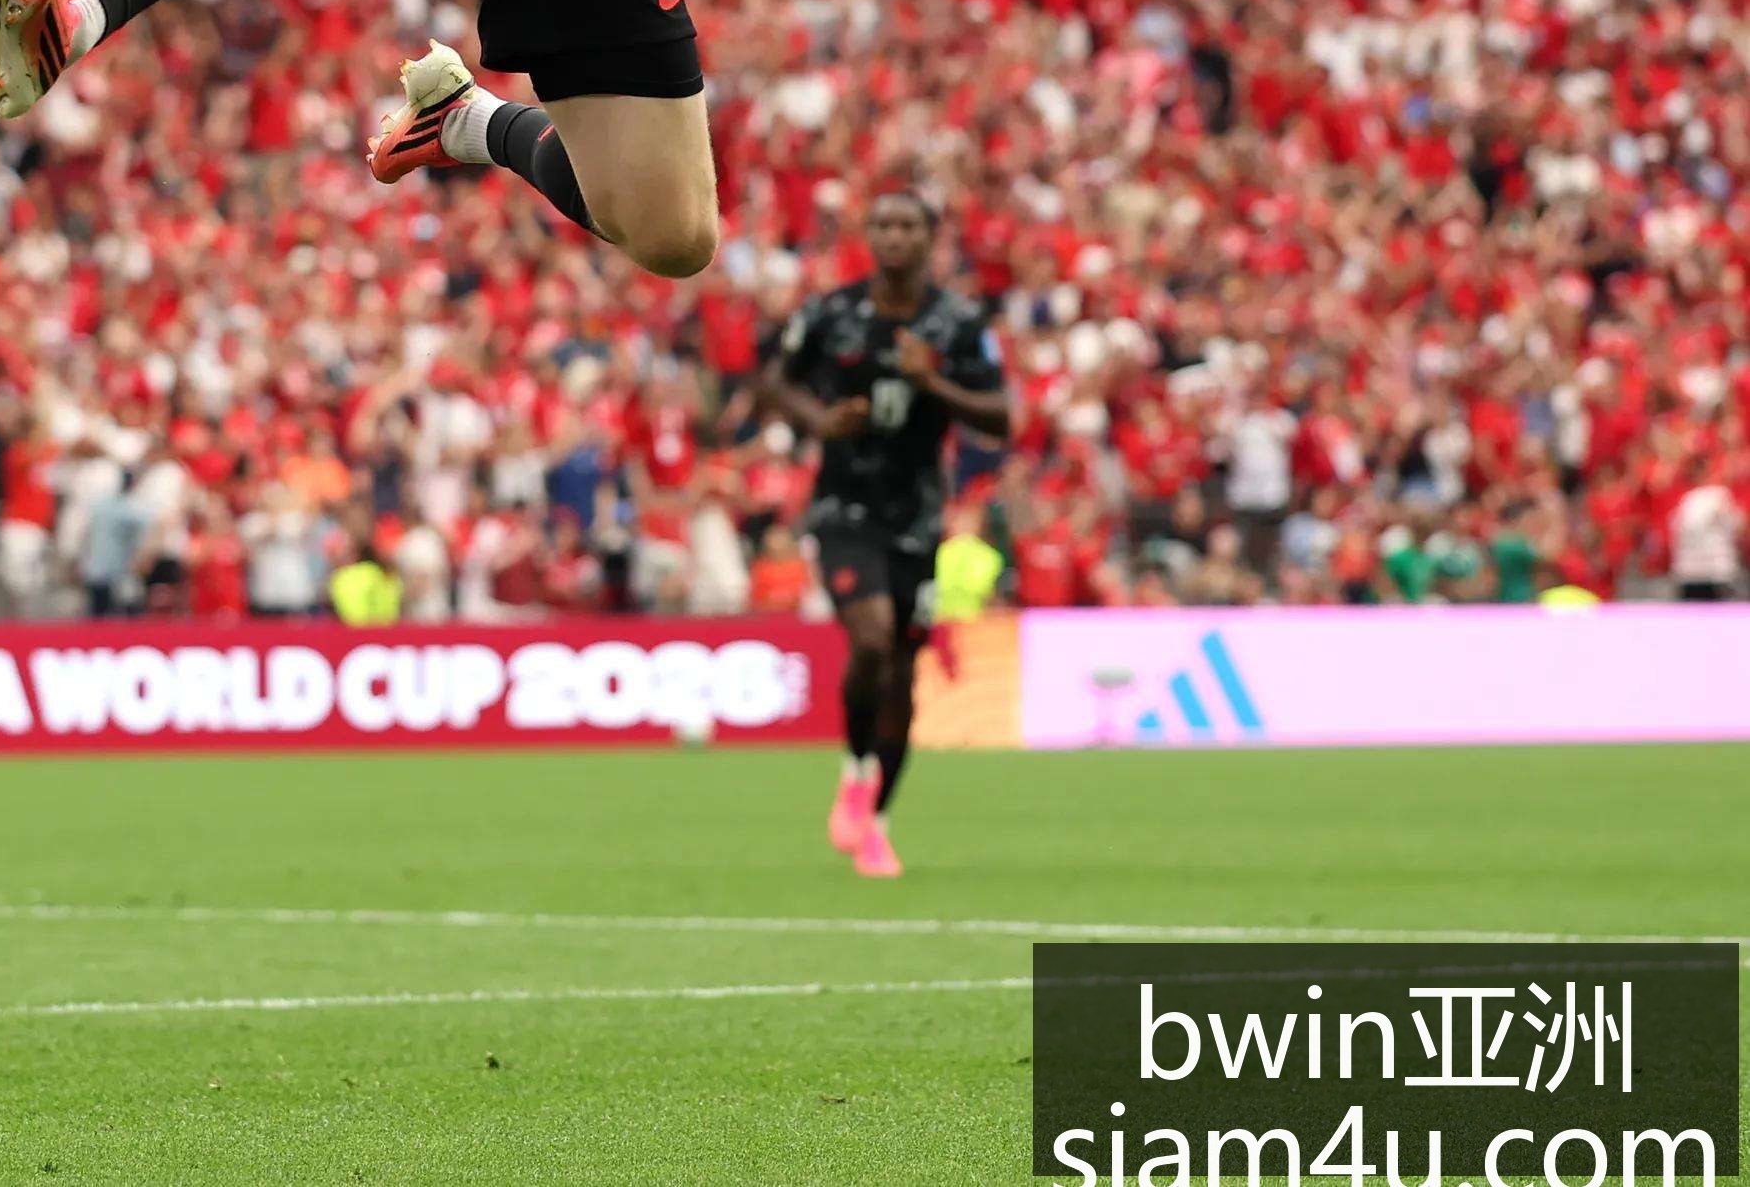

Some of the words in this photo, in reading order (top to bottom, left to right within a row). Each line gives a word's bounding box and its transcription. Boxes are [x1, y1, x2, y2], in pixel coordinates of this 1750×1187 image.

[30, 645, 336, 733] WORLD
[337, 644, 506, 731] CUP
[505, 640, 787, 730] 2026
